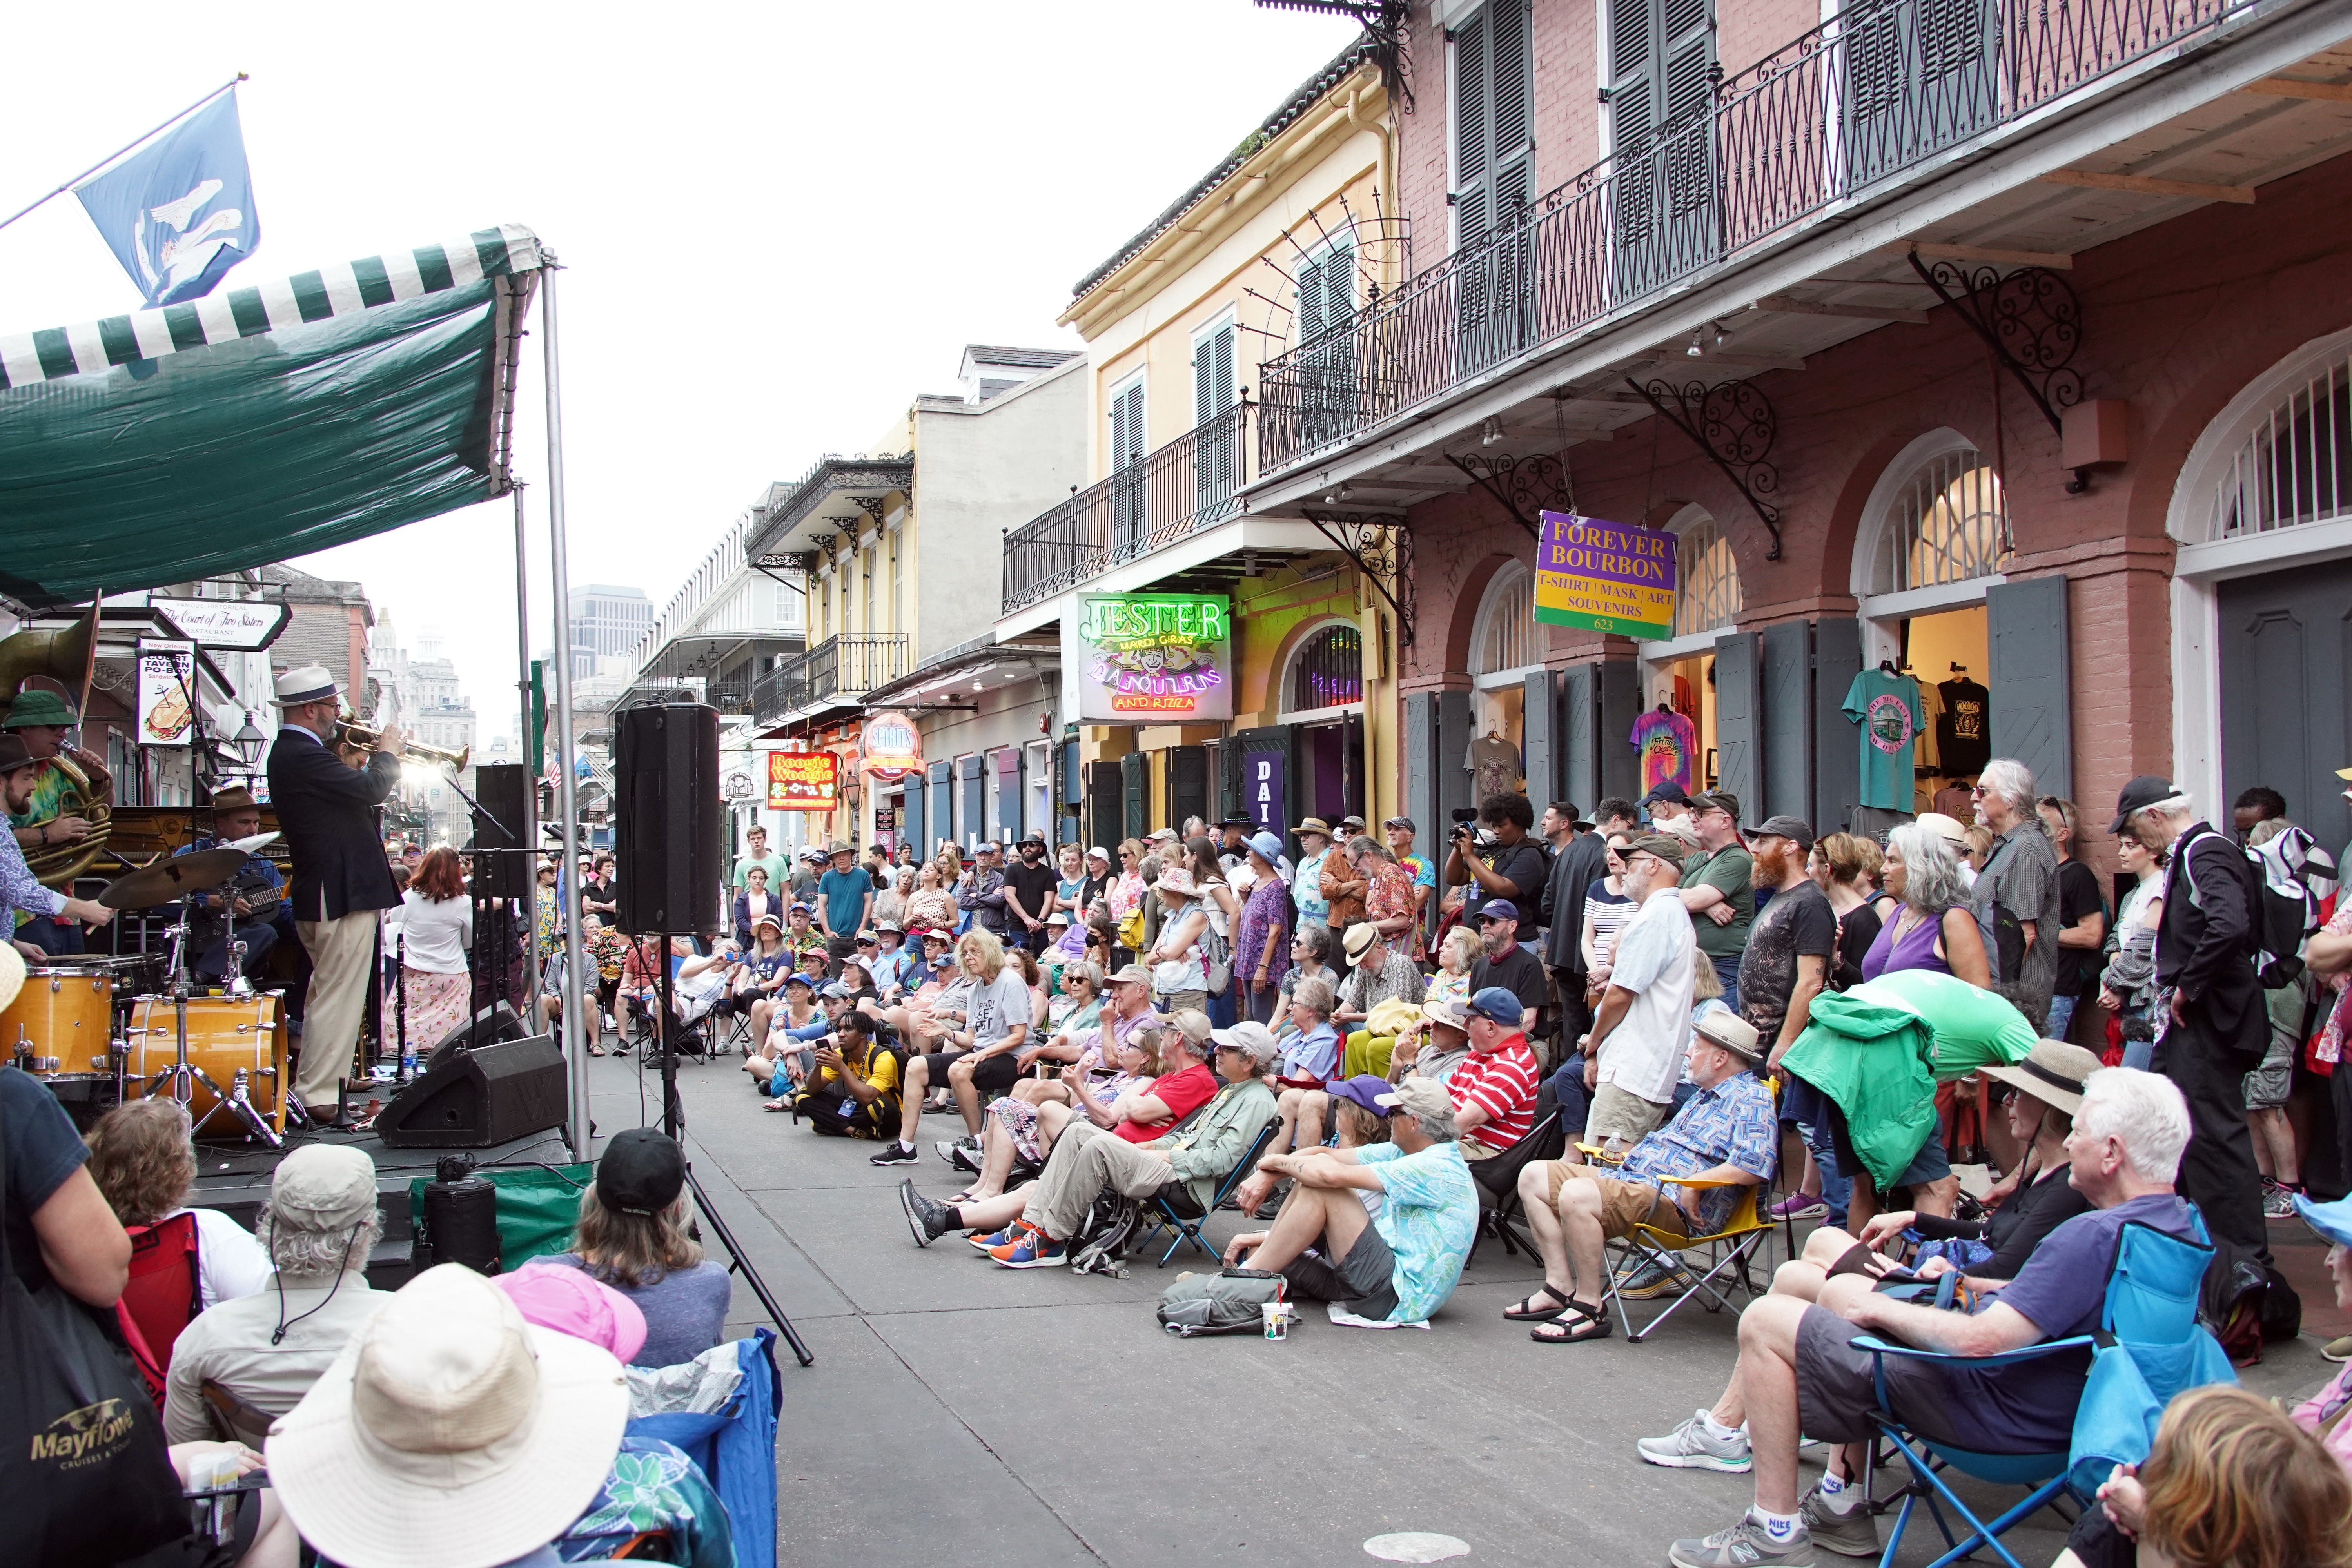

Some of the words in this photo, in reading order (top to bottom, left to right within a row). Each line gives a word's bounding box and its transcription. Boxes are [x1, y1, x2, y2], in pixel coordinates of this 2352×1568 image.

[1553, 522, 1665, 558] FOREVER
[1551, 545, 1665, 581] BOURBON
[1539, 574, 1590, 592] T-SHIRT
[1601, 584, 1638, 600] MASK
[1647, 593, 1673, 605] ART
[1568, 596, 1642, 617] SOUVENIRS
[163, 607, 179, 622] The
[181, 609, 205, 624] Court
[205, 613, 216, 626] of
[216, 611, 236, 628] Two
[238, 612, 263, 627] Sisters
[1081, 601, 1223, 640] JESTER
[1594, 618, 1613, 630] 623
[1119, 638, 1155, 650] MARDI
[1158, 635, 1193, 645] GRAS
[1116, 697, 1148, 708] AND
[1868, 699, 1881, 713] THE
[1896, 701, 1909, 717] EASY
[872, 727, 912, 748] SPIRITS
[1650, 737, 1677, 750] French
[1869, 733, 1880, 745] EW
[1883, 732, 1908, 751] ORLEANS
[772, 755, 831, 771] Boogie
[771, 768, 833, 784] Woogie
[979, 999, 995, 1009] RADY
[977, 1007, 994, 1020] SET
[1643, 1270, 1665, 1285] HOKA
[31, 1406, 134, 1461] Mayflowe
[1824, 1475, 1842, 1490] NIKE
[1769, 1518, 1790, 1529] NIKE
